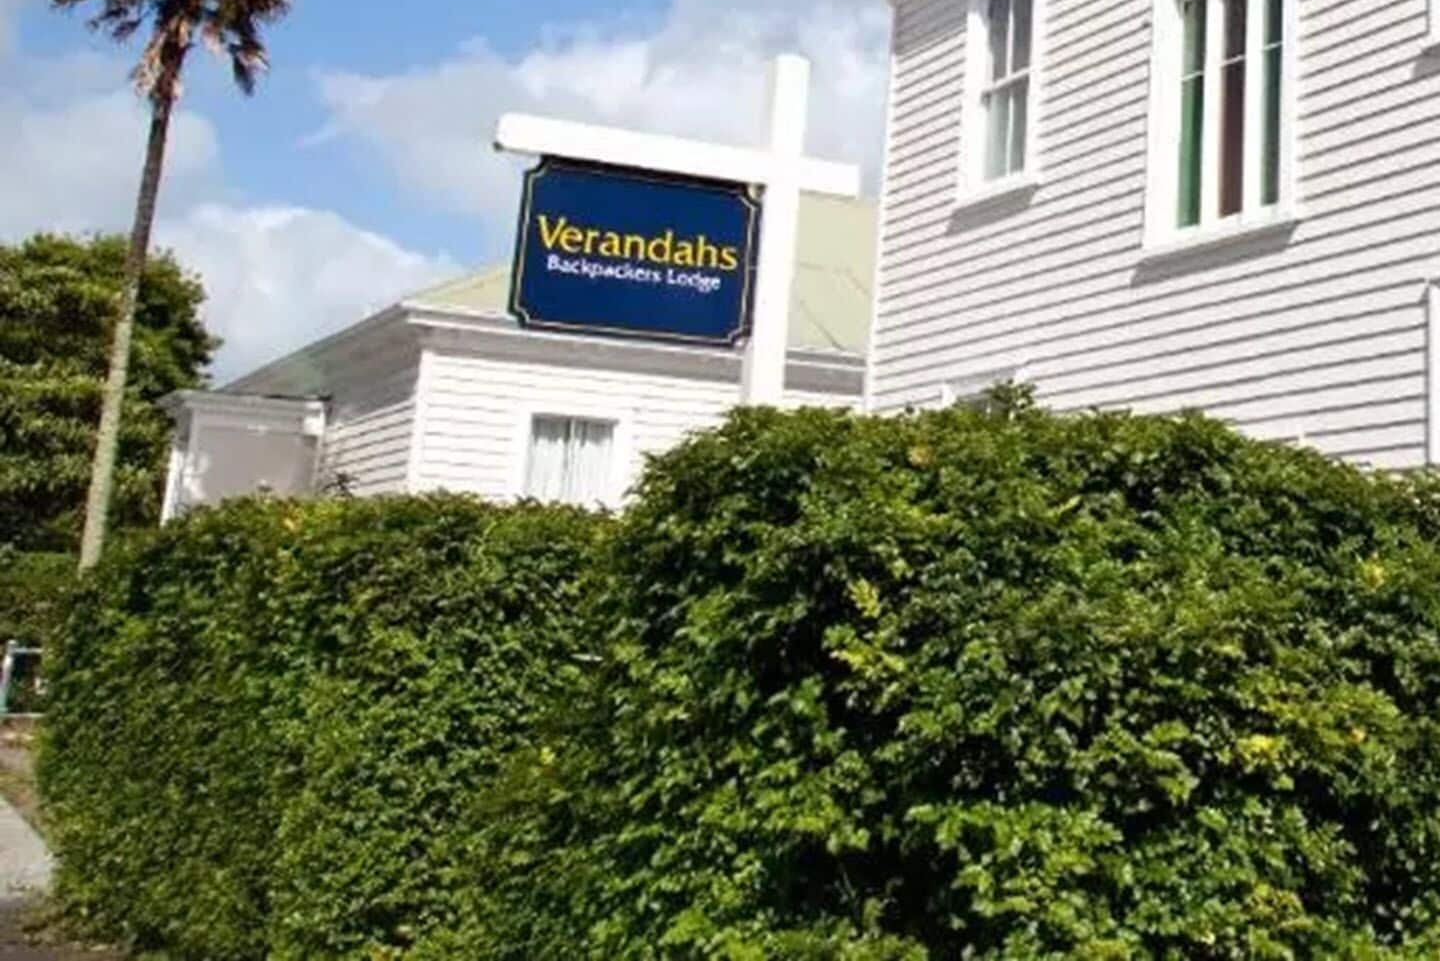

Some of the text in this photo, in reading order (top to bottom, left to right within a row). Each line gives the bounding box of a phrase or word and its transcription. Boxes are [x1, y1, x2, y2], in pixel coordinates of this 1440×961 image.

[537, 214, 738, 270] Verandahs
[547, 254, 722, 292] Backpackers Lodge
